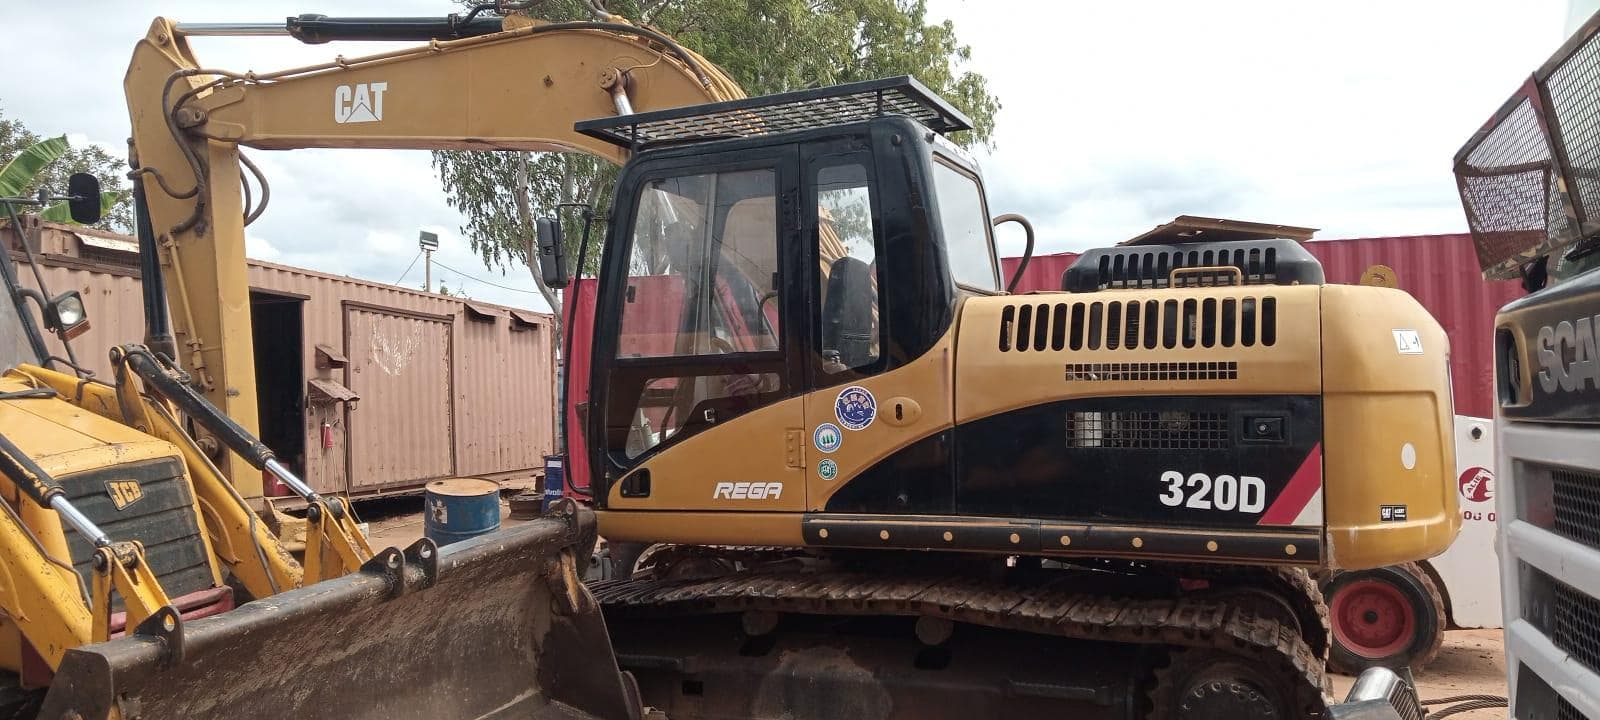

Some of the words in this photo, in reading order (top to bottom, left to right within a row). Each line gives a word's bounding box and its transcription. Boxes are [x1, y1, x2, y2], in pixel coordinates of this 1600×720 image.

[335, 82, 387, 123] CAT
[109, 481, 142, 507] JCB
[713, 482, 783, 499] REGA
[1159, 470, 1265, 514] 320D
